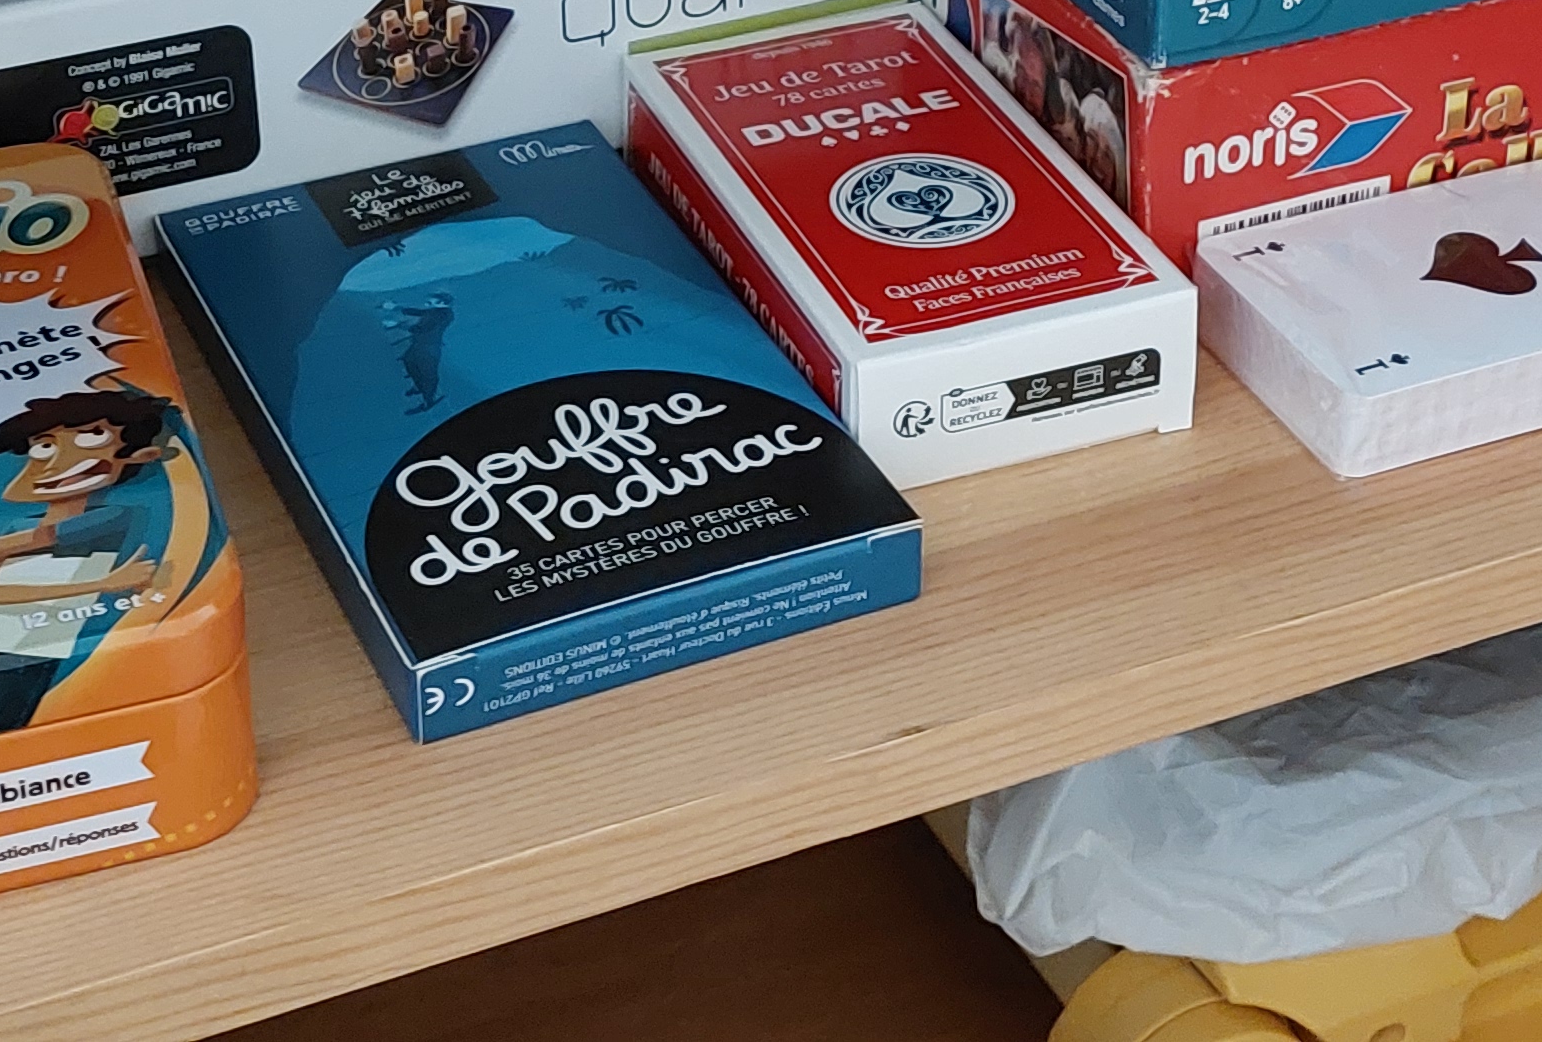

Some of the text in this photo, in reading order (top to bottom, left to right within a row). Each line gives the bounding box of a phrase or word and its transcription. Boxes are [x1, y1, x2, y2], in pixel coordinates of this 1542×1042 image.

[1196, 2, 1230, 26] 2-4
[713, 46, 921, 104] Jeu de Tarot
[771, 74, 886, 108] 78 cartes
[739, 88, 961, 148] DUCALE
[1435, 75, 1529, 144] La
[1183, 100, 1319, 185] noris
[350, 171, 438, 210] jeu de
[369, 177, 466, 219] familles
[371, 168, 406, 187] Le
[184, 196, 300, 228] GOUFFRE
[206, 204, 303, 232] PADIRAC
[357, 214, 384, 232] QUI
[690, 205, 735, 280] TAROT
[883, 246, 1086, 304] Qualité Premium
[912, 265, 1082, 314] Faces Françaises
[949, 407, 1003, 428] RECYCLEZ
[951, 390, 999, 410] DONNEZ
[394, 391, 728, 533] gouffre
[410, 423, 824, 586] de Padirac
[493, 507, 798, 604] LES MYSTÈRES DU GOUFFRE
[506, 495, 780, 582] 35 CARTES POUR PERCER
[21, 592, 144, 632] 12 ans et
[565, 638, 607, 661] MINUS
